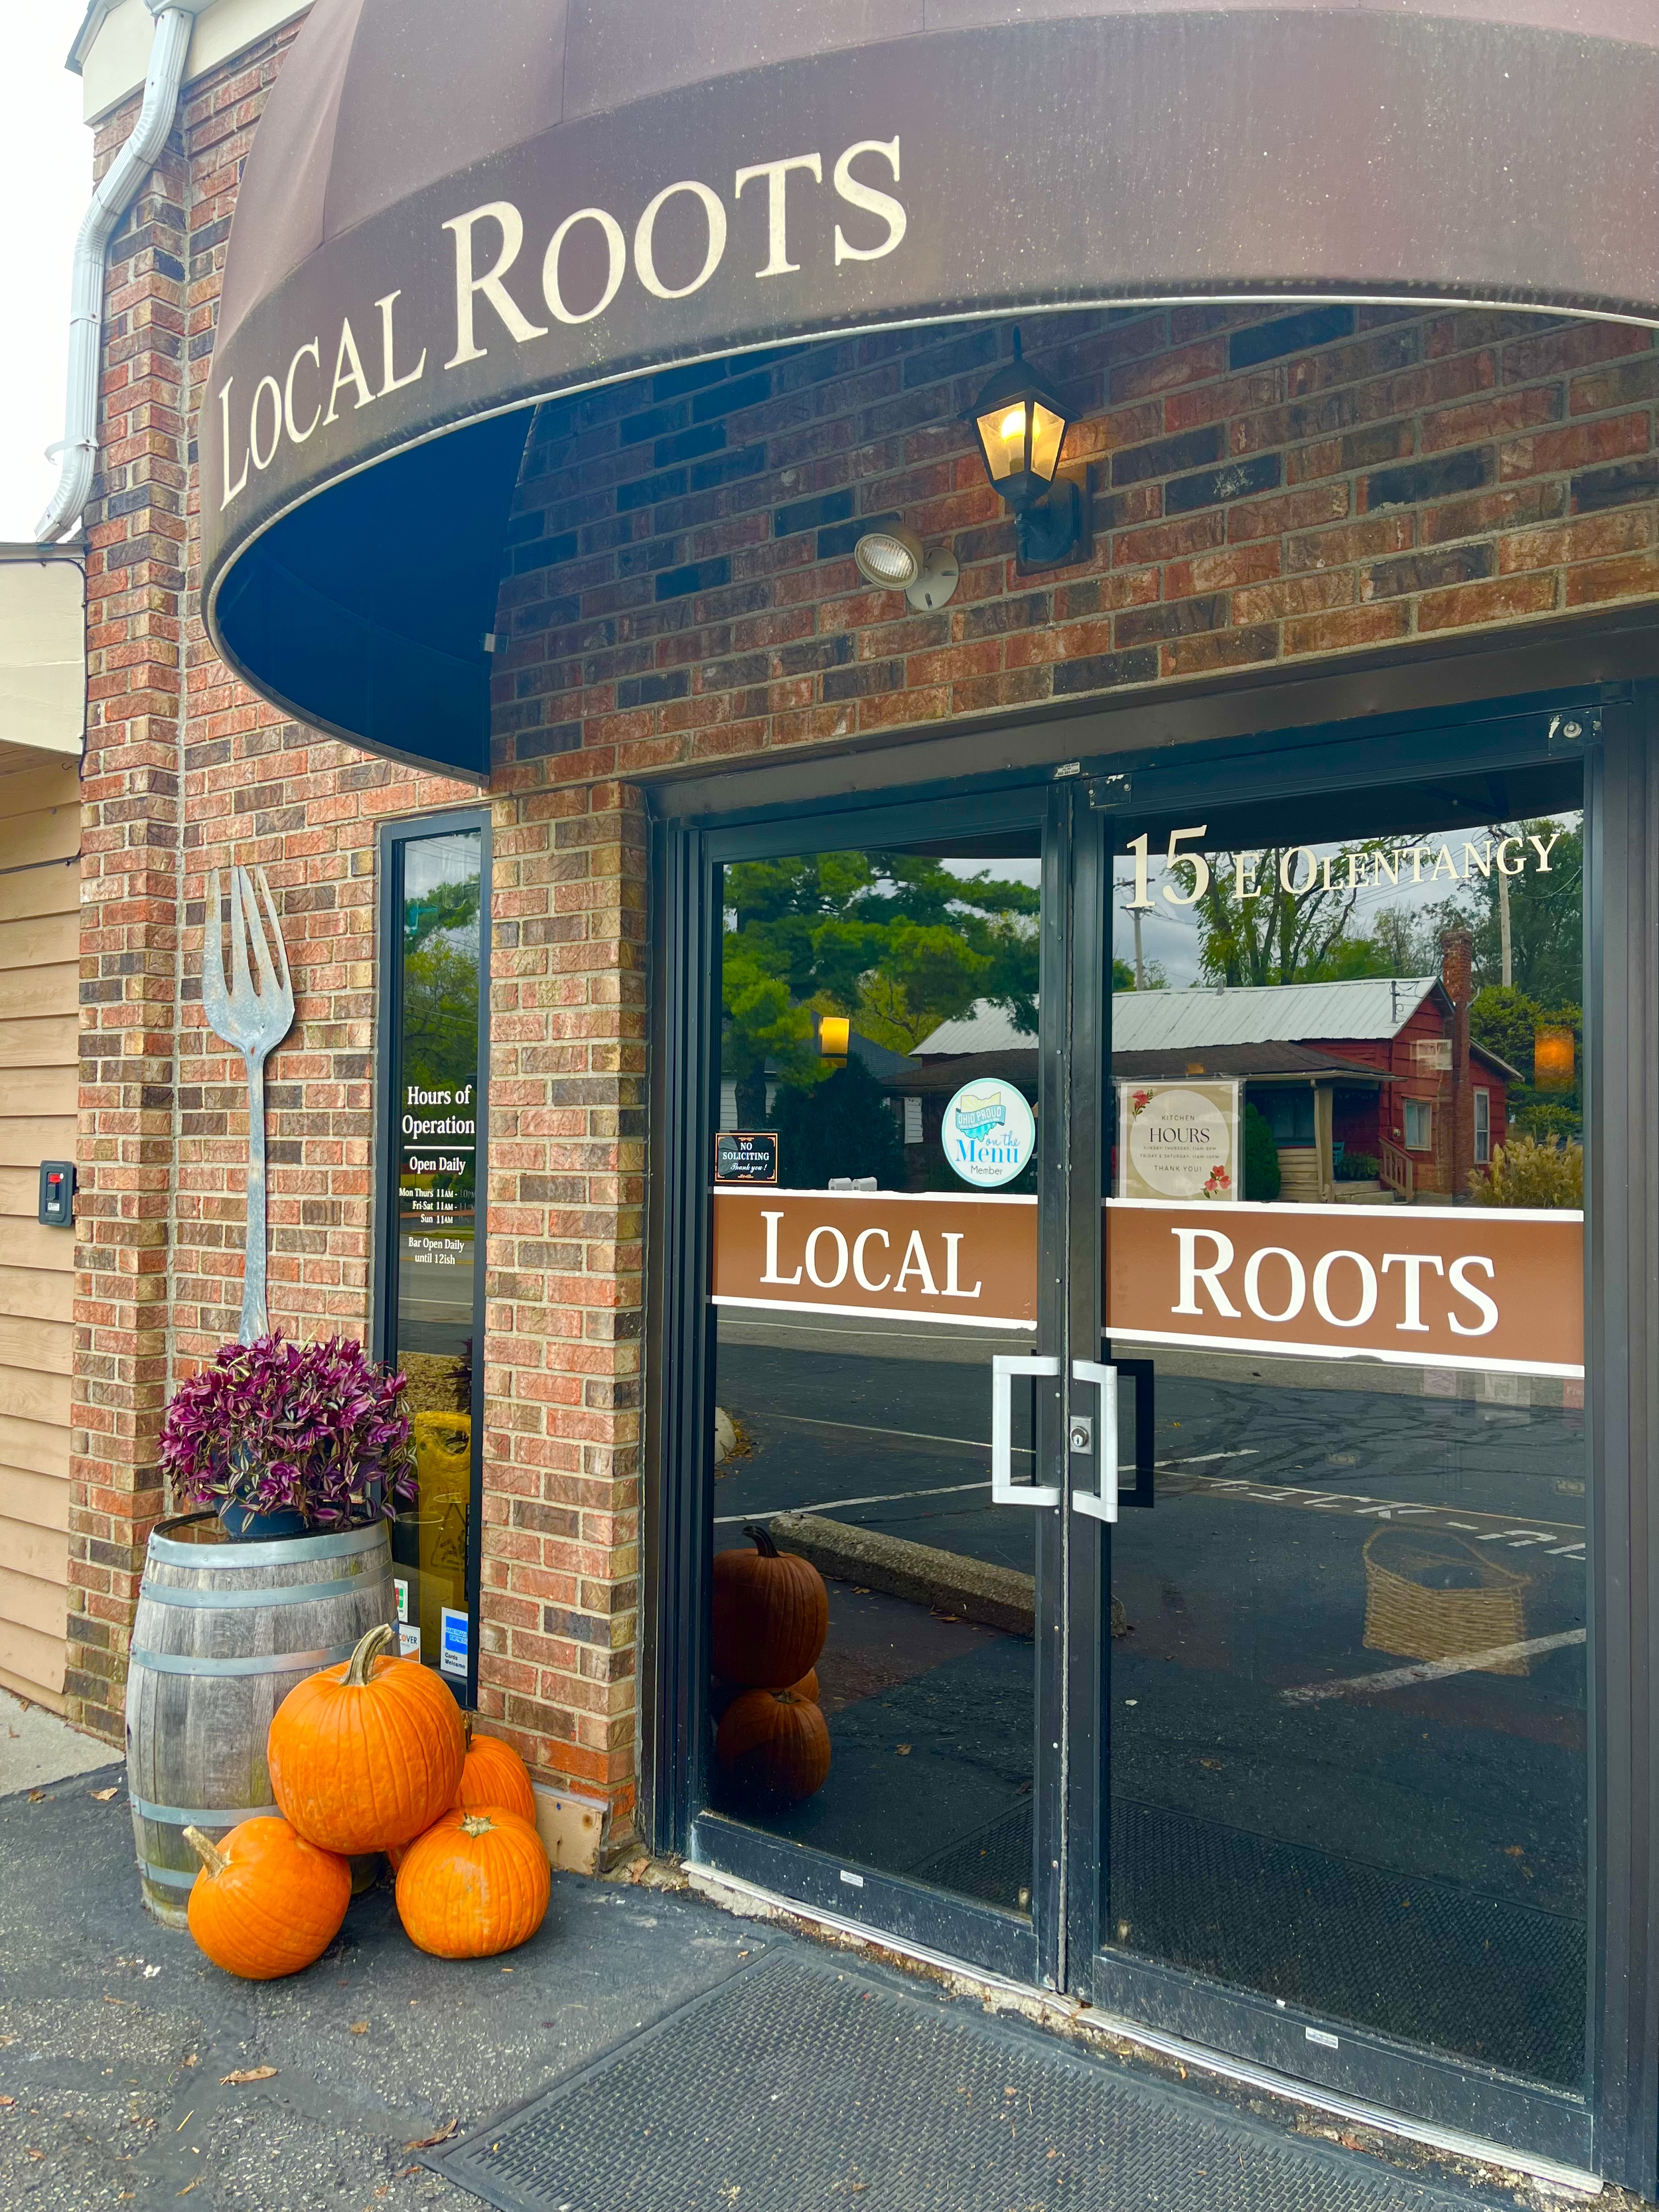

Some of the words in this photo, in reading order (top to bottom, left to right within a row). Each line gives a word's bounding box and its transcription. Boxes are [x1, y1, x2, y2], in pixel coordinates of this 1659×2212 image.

[219, 289, 426, 511] LOCAL
[441, 135, 907, 370] ROOTS
[1126, 824, 1209, 908] 15
[1232, 853, 1262, 899] E
[1280, 834, 1560, 895] OLENTANGY
[407, 1086, 451, 1104] Hours
[455, 1084, 472, 1104] of
[958, 1113, 975, 1124] OHIO
[976, 1106, 1001, 1121] PROUD
[402, 1115, 475, 1139] Operation
[985, 1137, 1001, 1146] on
[1000, 1130, 1021, 1147] the
[1150, 1128, 1210, 1143] HOURS
[723, 1151, 770, 1161] SOLICITING
[954, 1139, 1020, 1163] Menu
[409, 1156, 437, 1174] Open
[439, 1157, 466, 1175] Daily
[971, 1165, 1003, 1175] Member
[399, 1188, 413, 1197] Mon
[415, 1188, 433, 1197] Thurs
[437, 1189, 454, 1198] 11AM
[412, 1201, 434, 1211] Fri-Sat
[437, 1202, 453, 1211] 11AM
[421, 1214, 433, 1223] Sun
[437, 1215, 453, 1224] 11AM
[408, 1237, 421, 1247] Bar
[423, 1238, 443, 1251] Open
[445, 1239, 465, 1253] Daily
[415, 1253, 432, 1263] until
[435, 1254, 455, 1264] 12ish
[760, 1211, 982, 1297] LOCAL
[1171, 1228, 1498, 1335] ROOTS
[446, 1627, 467, 1637] AMERICAN
[450, 1635, 468, 1645] EXPRESS
[445, 1659, 466, 1669] Welcome
